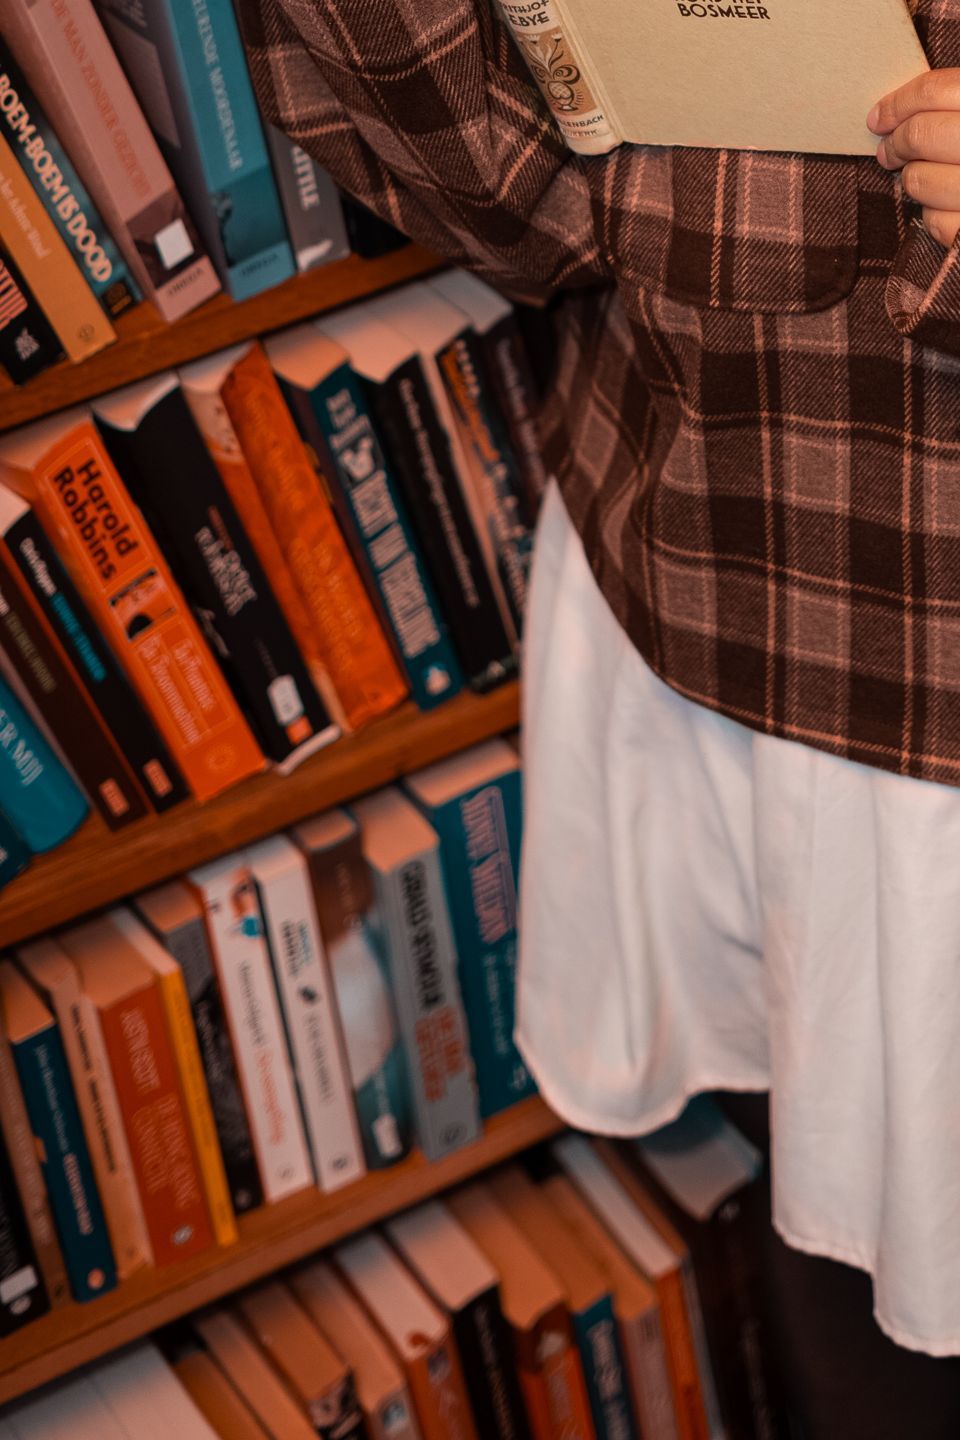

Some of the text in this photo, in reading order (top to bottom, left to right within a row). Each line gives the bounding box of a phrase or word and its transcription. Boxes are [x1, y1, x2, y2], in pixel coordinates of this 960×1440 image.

[678, 3, 770, 20] BOSMEER
[0, 73, 70, 201] BOEM-BOEM
[55, 195, 80, 220] IS
[65, 213, 114, 283] DOOD
[53, 467, 117, 582] Robbins
[76, 459, 138, 557] Harold
